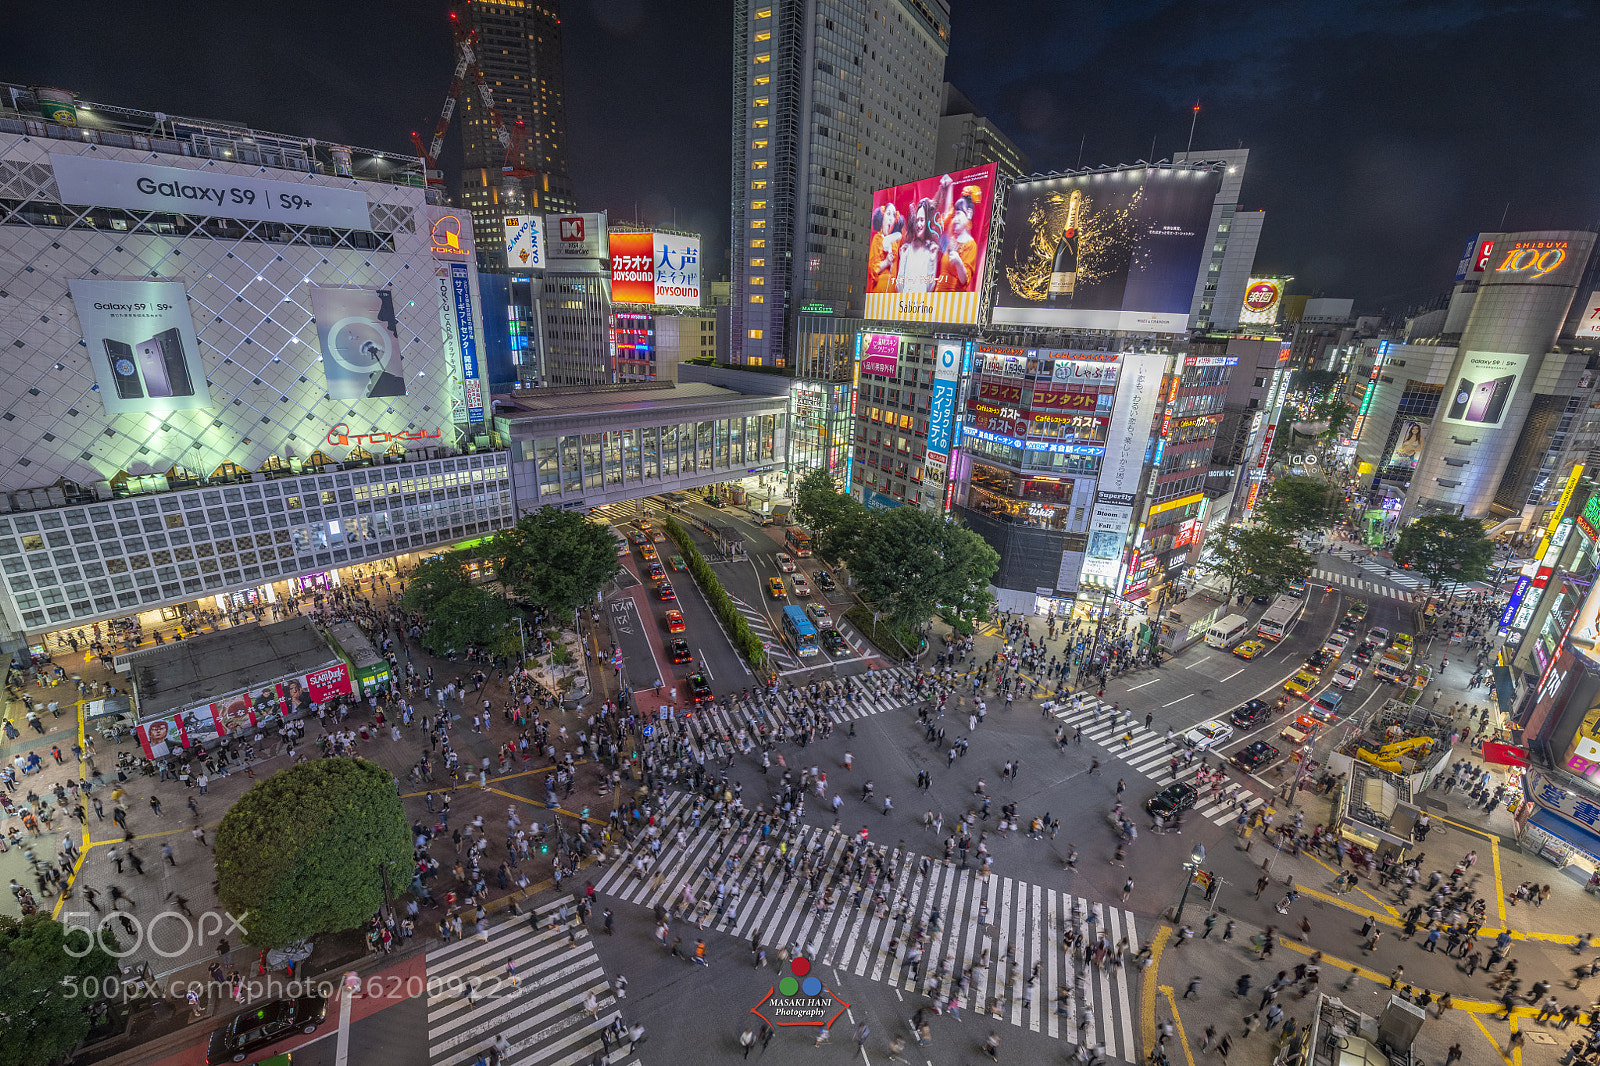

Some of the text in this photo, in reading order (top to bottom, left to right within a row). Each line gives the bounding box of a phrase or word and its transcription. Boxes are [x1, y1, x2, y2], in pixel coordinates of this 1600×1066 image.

[136, 177, 312, 210] Galaxy S9 S9+
[508, 222, 528, 252] SANKYO
[530, 220, 540, 264] SANKYO
[430, 246, 470, 255] TOKYU
[656, 244, 698, 270] 大声
[612, 255, 652, 270] カラオケ
[1495, 248, 1567, 279] 109
[613, 271, 653, 282] JOYSOUND
[656, 285, 698, 297] JOYSOUND
[1248, 291, 1274, 303] 楽園
[93, 302, 173, 311] Galaxy S9 S9+
[980, 345, 1025, 356] しゃぶしゃぶバイキング
[1049, 351, 1119, 362] しゃぶしゃぶバイキング
[1075, 365, 1117, 379] しゃぶ葉
[1033, 392, 1095, 407] コンタクト
[930, 385, 946, 446] アイシティ
[940, 387, 954, 448] コンタクトの
[1000, 407, 1021, 420] ガスト
[987, 417, 1013, 433] ガスト
[1071, 416, 1102, 428] ガスト
[349, 428, 441, 445] TOKYU
[1049, 444, 1104, 455] 英会話イーオン
[1098, 491, 1133, 501] Superfly
[1170, 552, 1187, 566] LUSH
